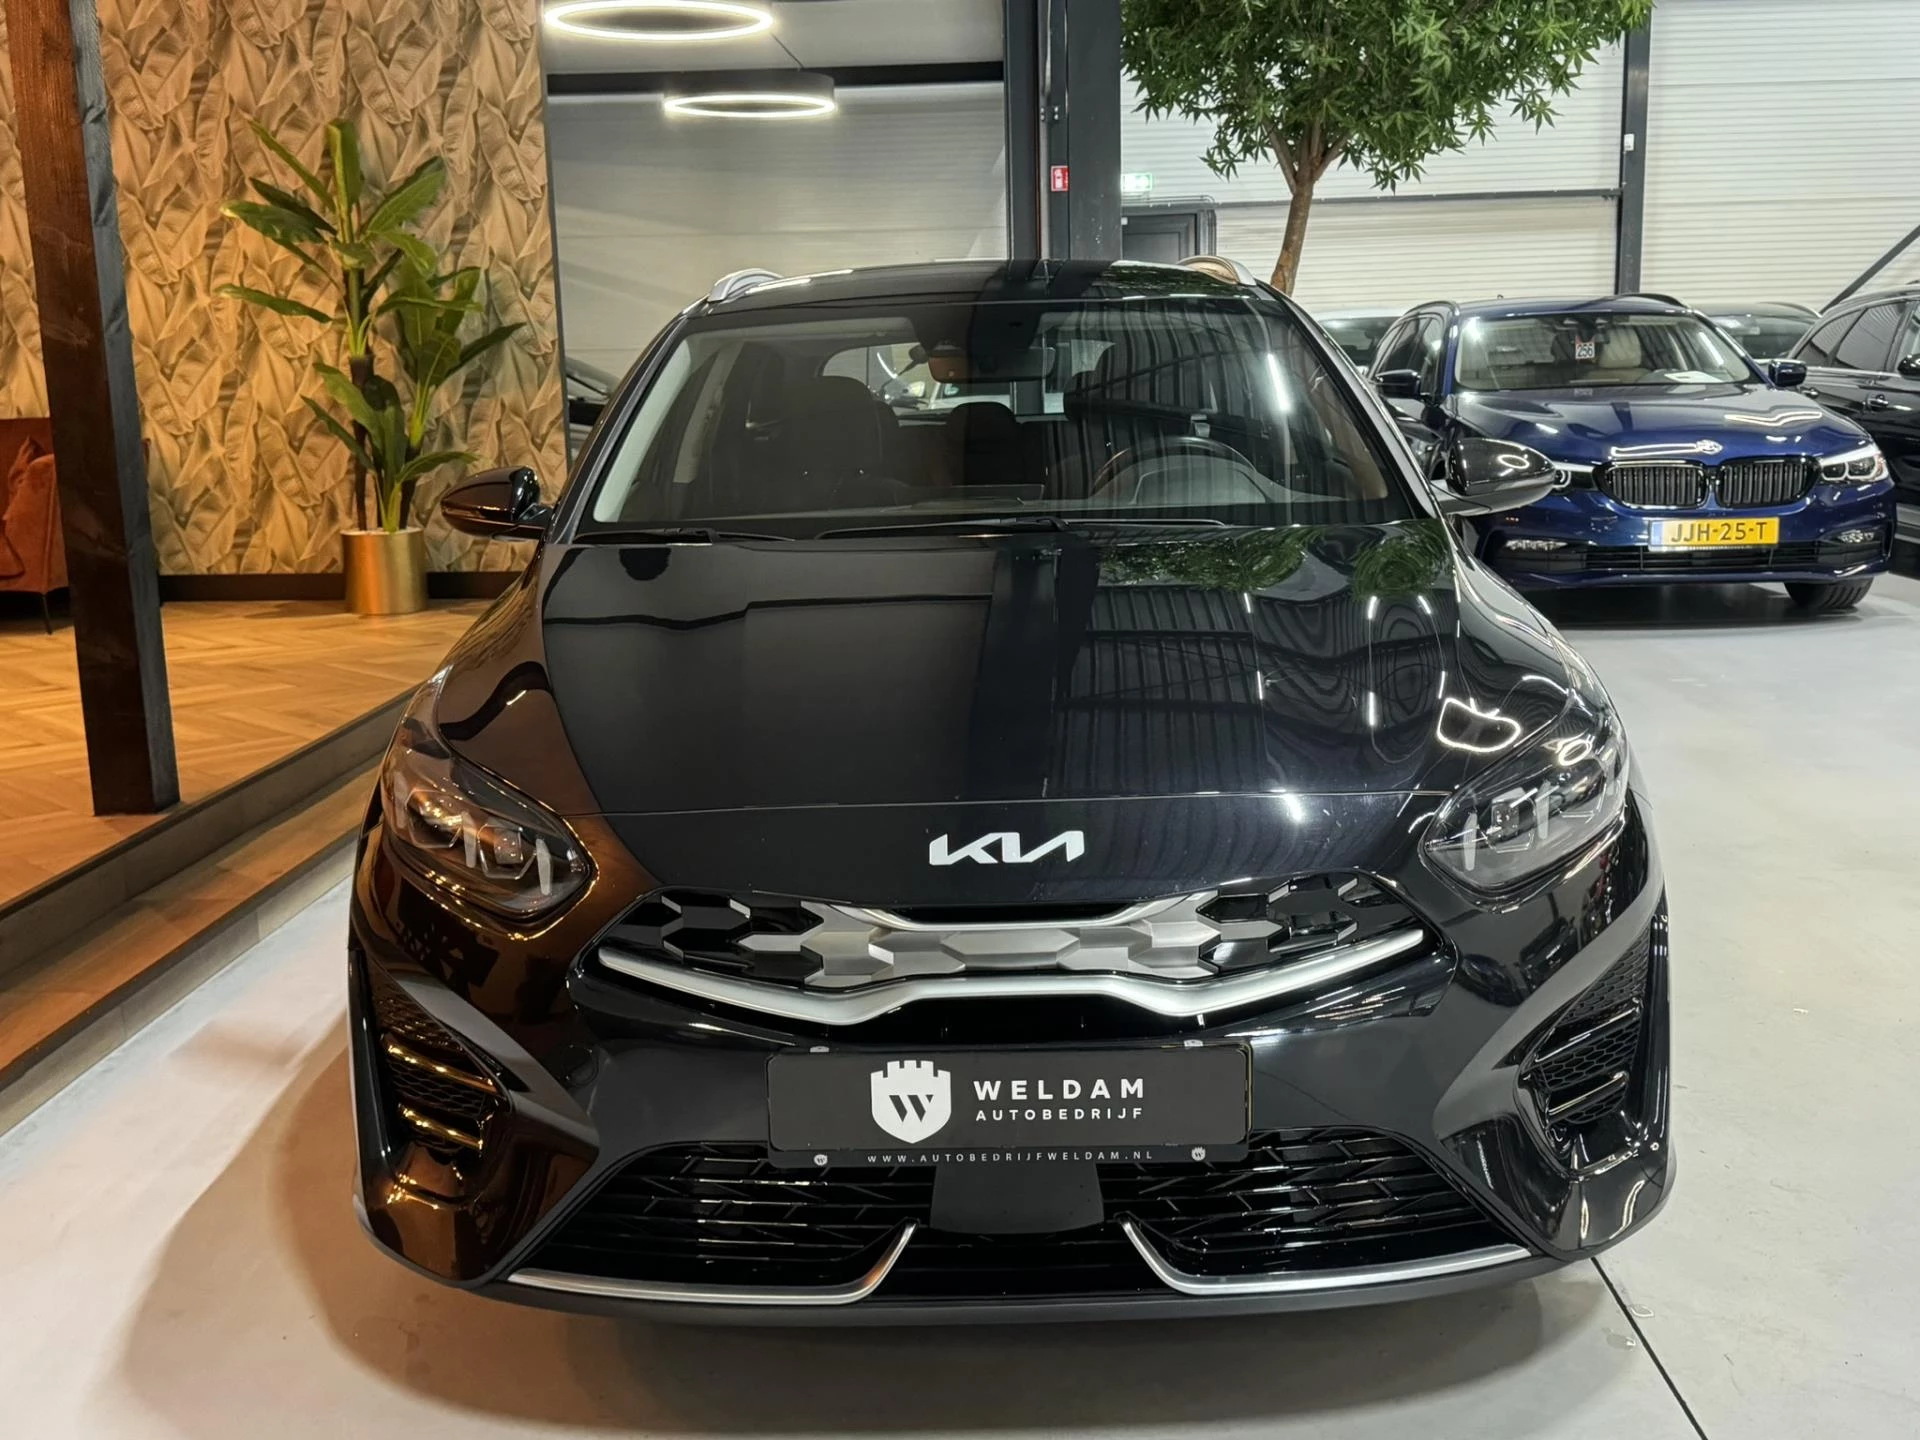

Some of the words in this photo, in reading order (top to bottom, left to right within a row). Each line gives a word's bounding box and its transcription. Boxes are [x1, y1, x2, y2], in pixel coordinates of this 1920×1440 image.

[1671, 522, 1767, 542] JJH-25-T
[929, 830, 1085, 866] KIA
[973, 1078, 1143, 1100] WELDAM
[975, 1107, 1142, 1121] AUTOBEDRIJF
[867, 1151, 1153, 1163] WWW.AUTOBEDRIJFWELDAM.NL
